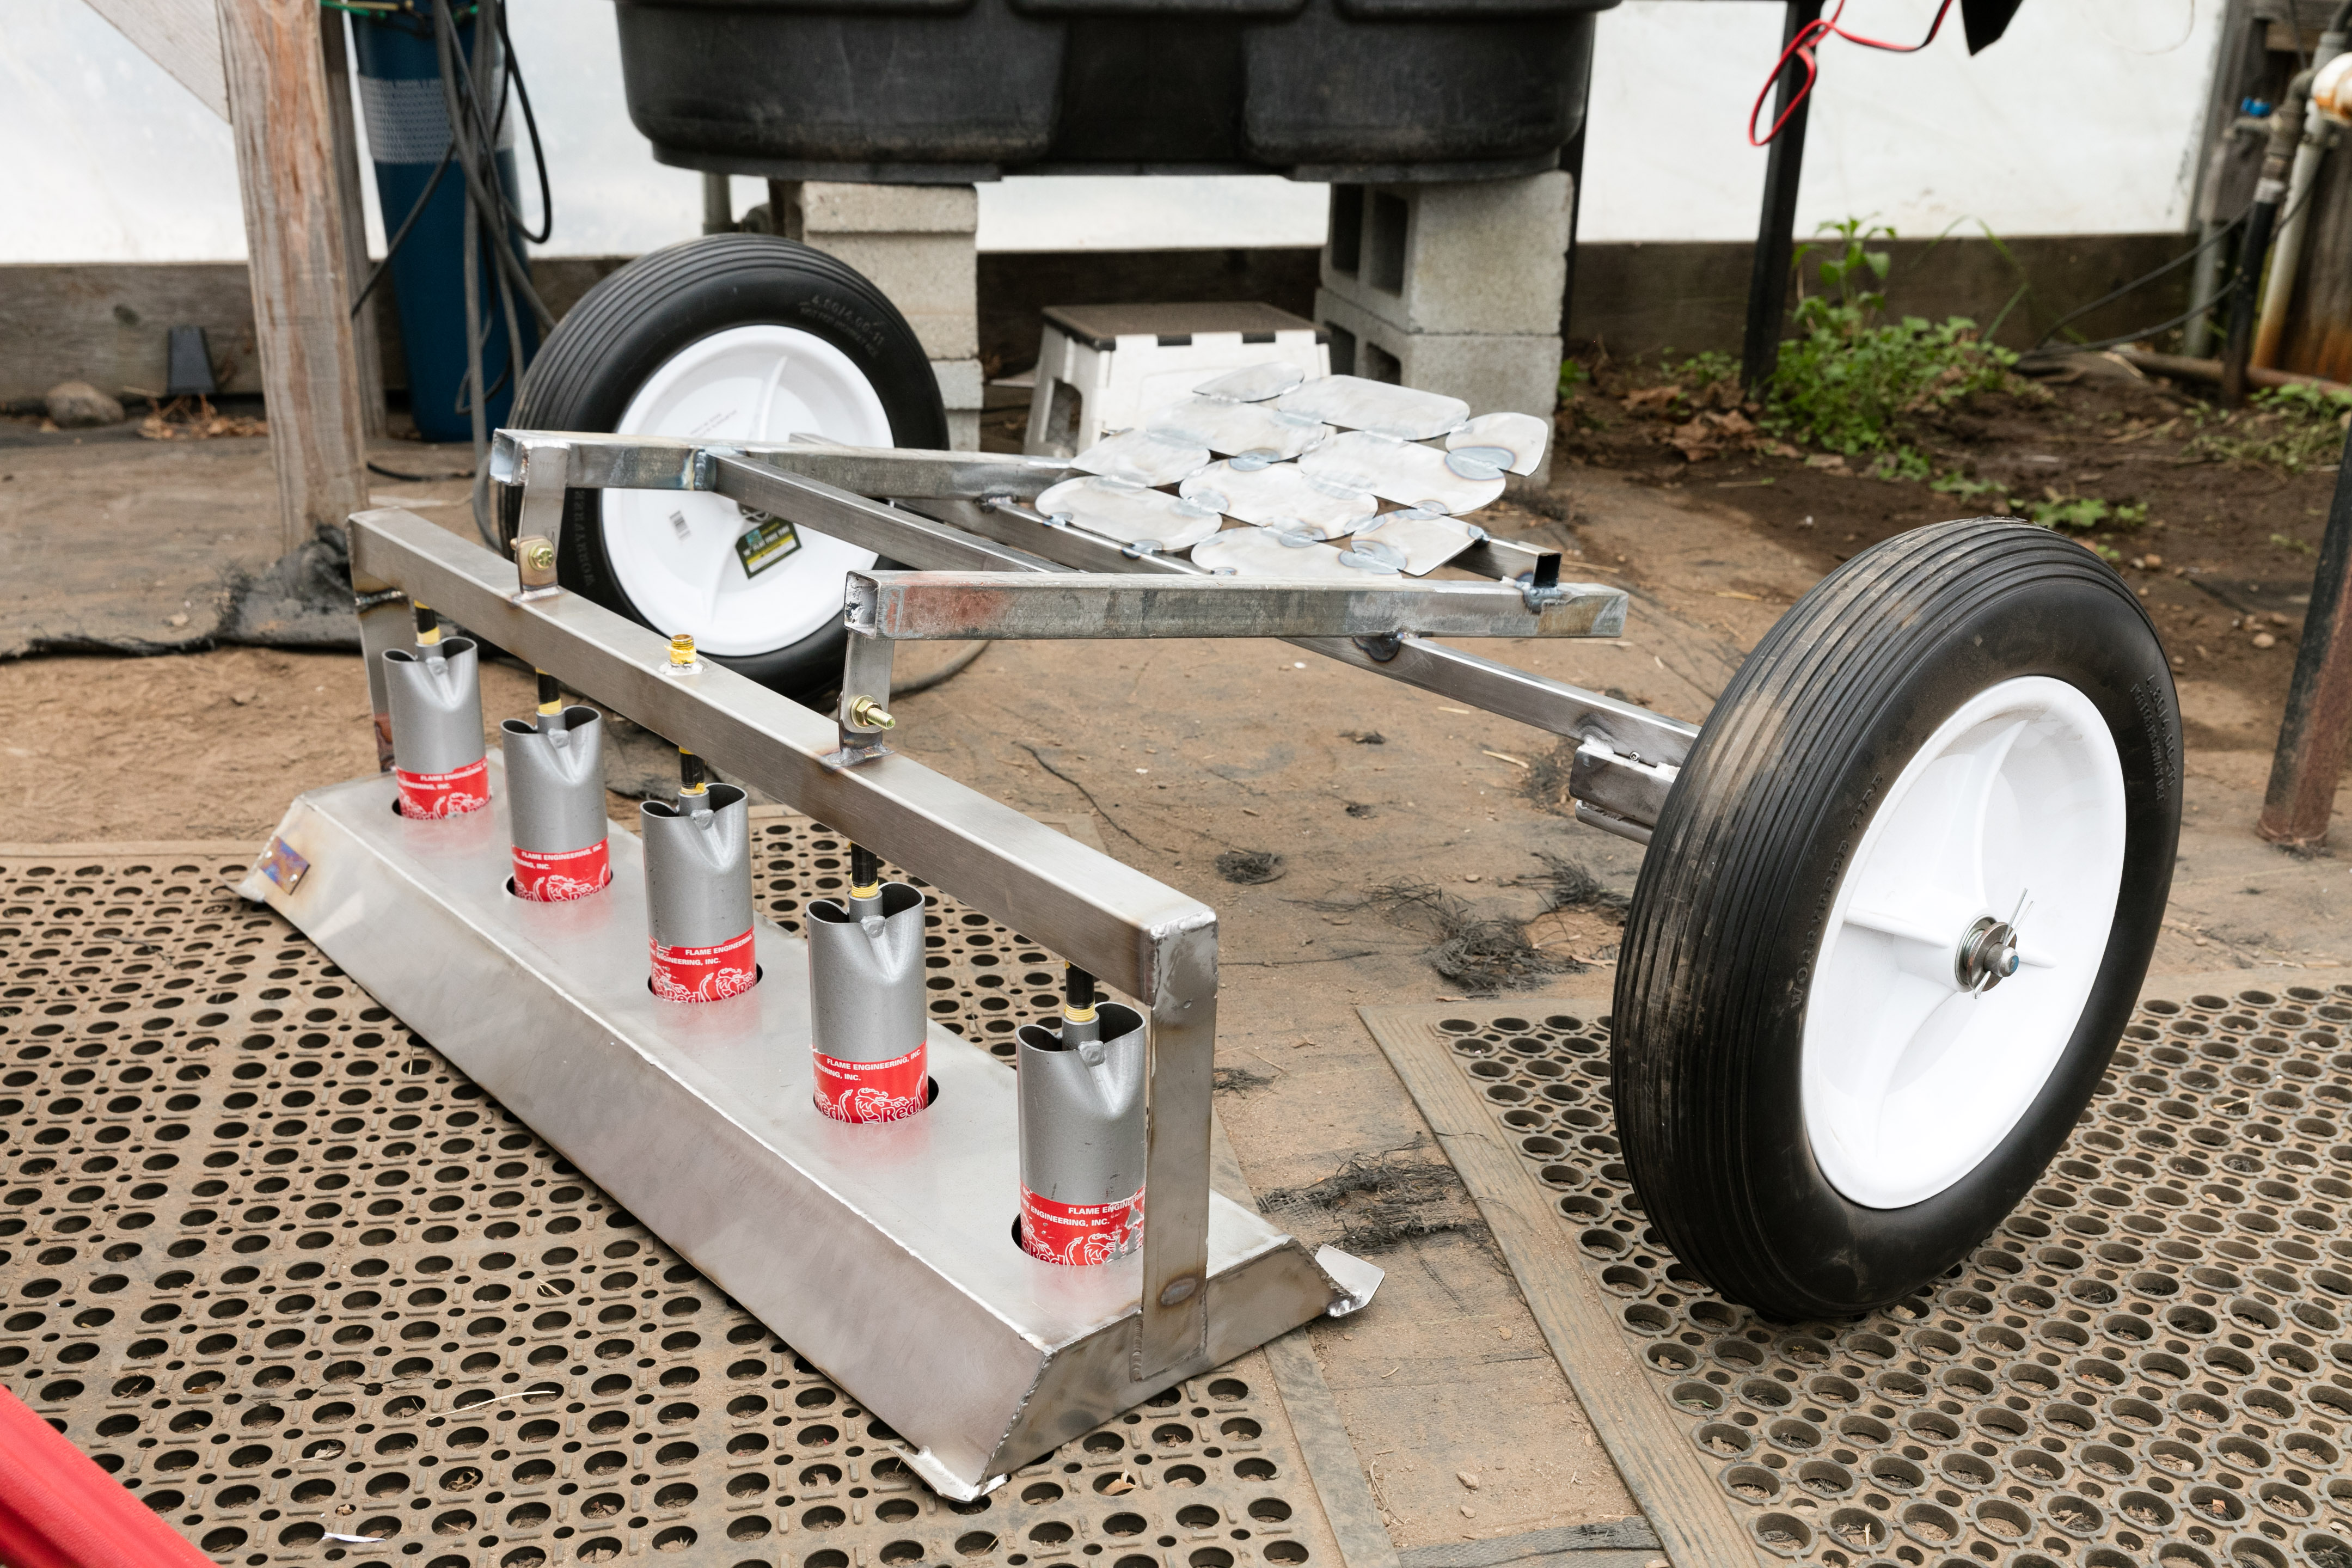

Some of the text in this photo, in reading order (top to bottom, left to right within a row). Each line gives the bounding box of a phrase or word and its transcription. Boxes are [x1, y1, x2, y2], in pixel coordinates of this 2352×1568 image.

[521, 851, 542, 860] FLAME
[826, 1049, 922, 1070] FLAME ENGINEERING, INC.
[881, 1097, 918, 1124] Red
[1031, 1205, 1088, 1227] ENGINEERING,
[1091, 1218, 1110, 1226] INC.
